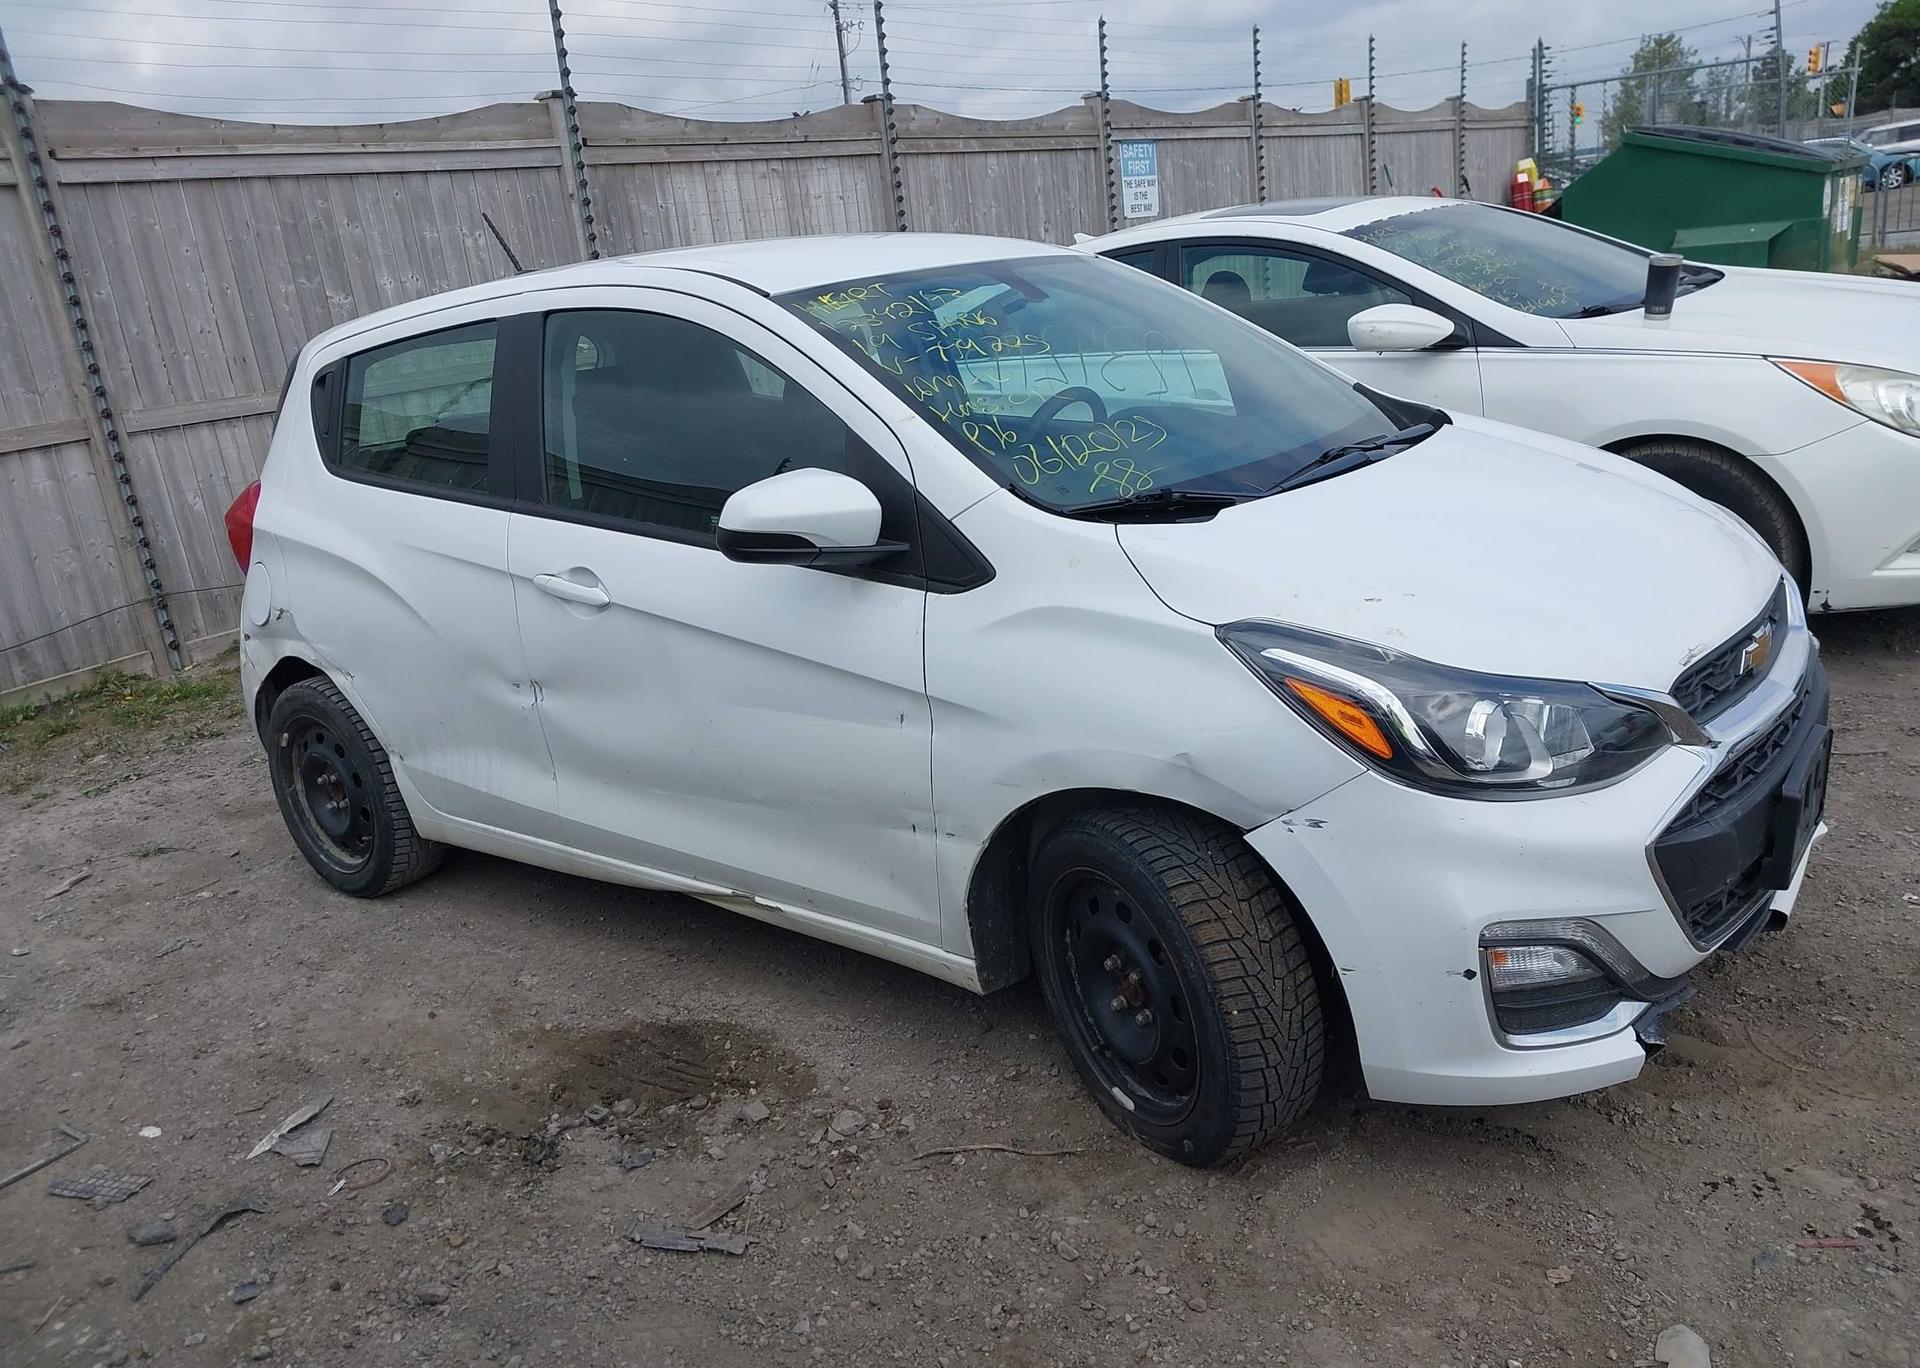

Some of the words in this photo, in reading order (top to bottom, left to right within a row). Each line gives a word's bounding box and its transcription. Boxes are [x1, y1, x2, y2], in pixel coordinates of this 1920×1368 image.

[1122, 143, 1153, 158] SAFETY
[1128, 160, 1150, 174] FIRST
[1124, 179, 1133, 189] THE
[1134, 178, 1146, 189] SAFE
[1147, 178, 1156, 188] WAY
[1134, 191, 1139, 200] IS
[1139, 190, 1148, 200] THE
[1130, 204, 1143, 214] BEST
[1143, 203, 1153, 213] WAY
[907, 309, 998, 338] SPARK
